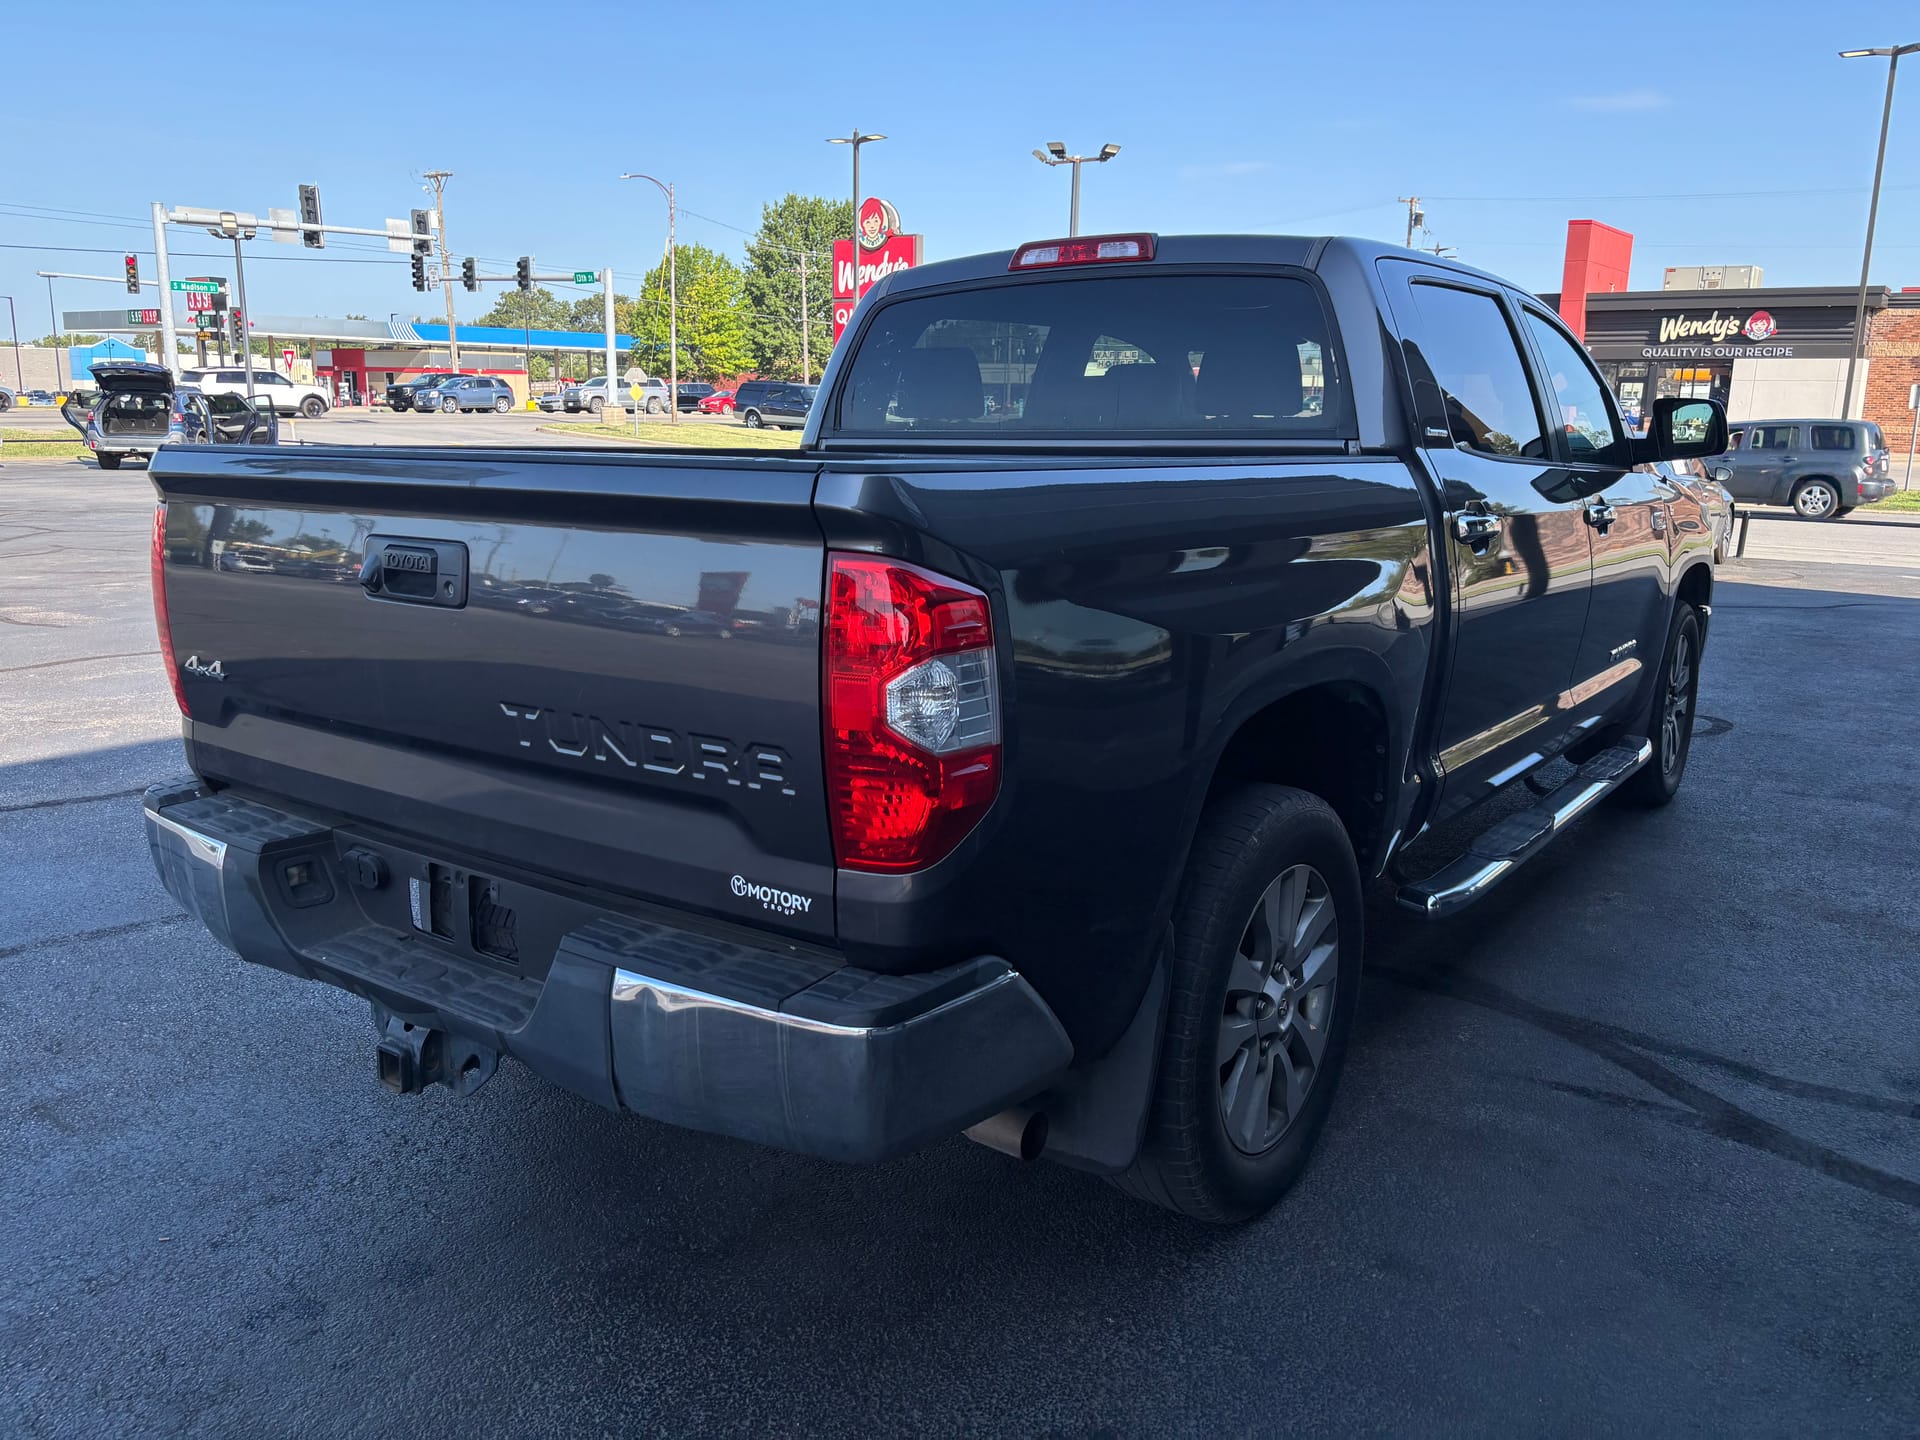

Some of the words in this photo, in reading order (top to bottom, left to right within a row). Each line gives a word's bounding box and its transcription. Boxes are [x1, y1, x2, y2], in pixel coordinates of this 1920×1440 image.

[173, 281, 179, 290] S
[180, 282, 208, 291] Madison
[1659, 310, 1741, 343] Wendy's
[1094, 351, 1138, 359] WAFFLE
[1642, 347, 1698, 358] QUALITY
[1700, 347, 1712, 358] IS
[1714, 347, 1744, 358] OUR
[1745, 346, 1793, 357] RECIPE
[384, 551, 431, 572] TOYOTA
[184, 655, 225, 677] 4x4
[500, 700, 797, 797] TUNDRA
[747, 882, 812, 912] MOTORY
[763, 902, 796, 916] GROUP
